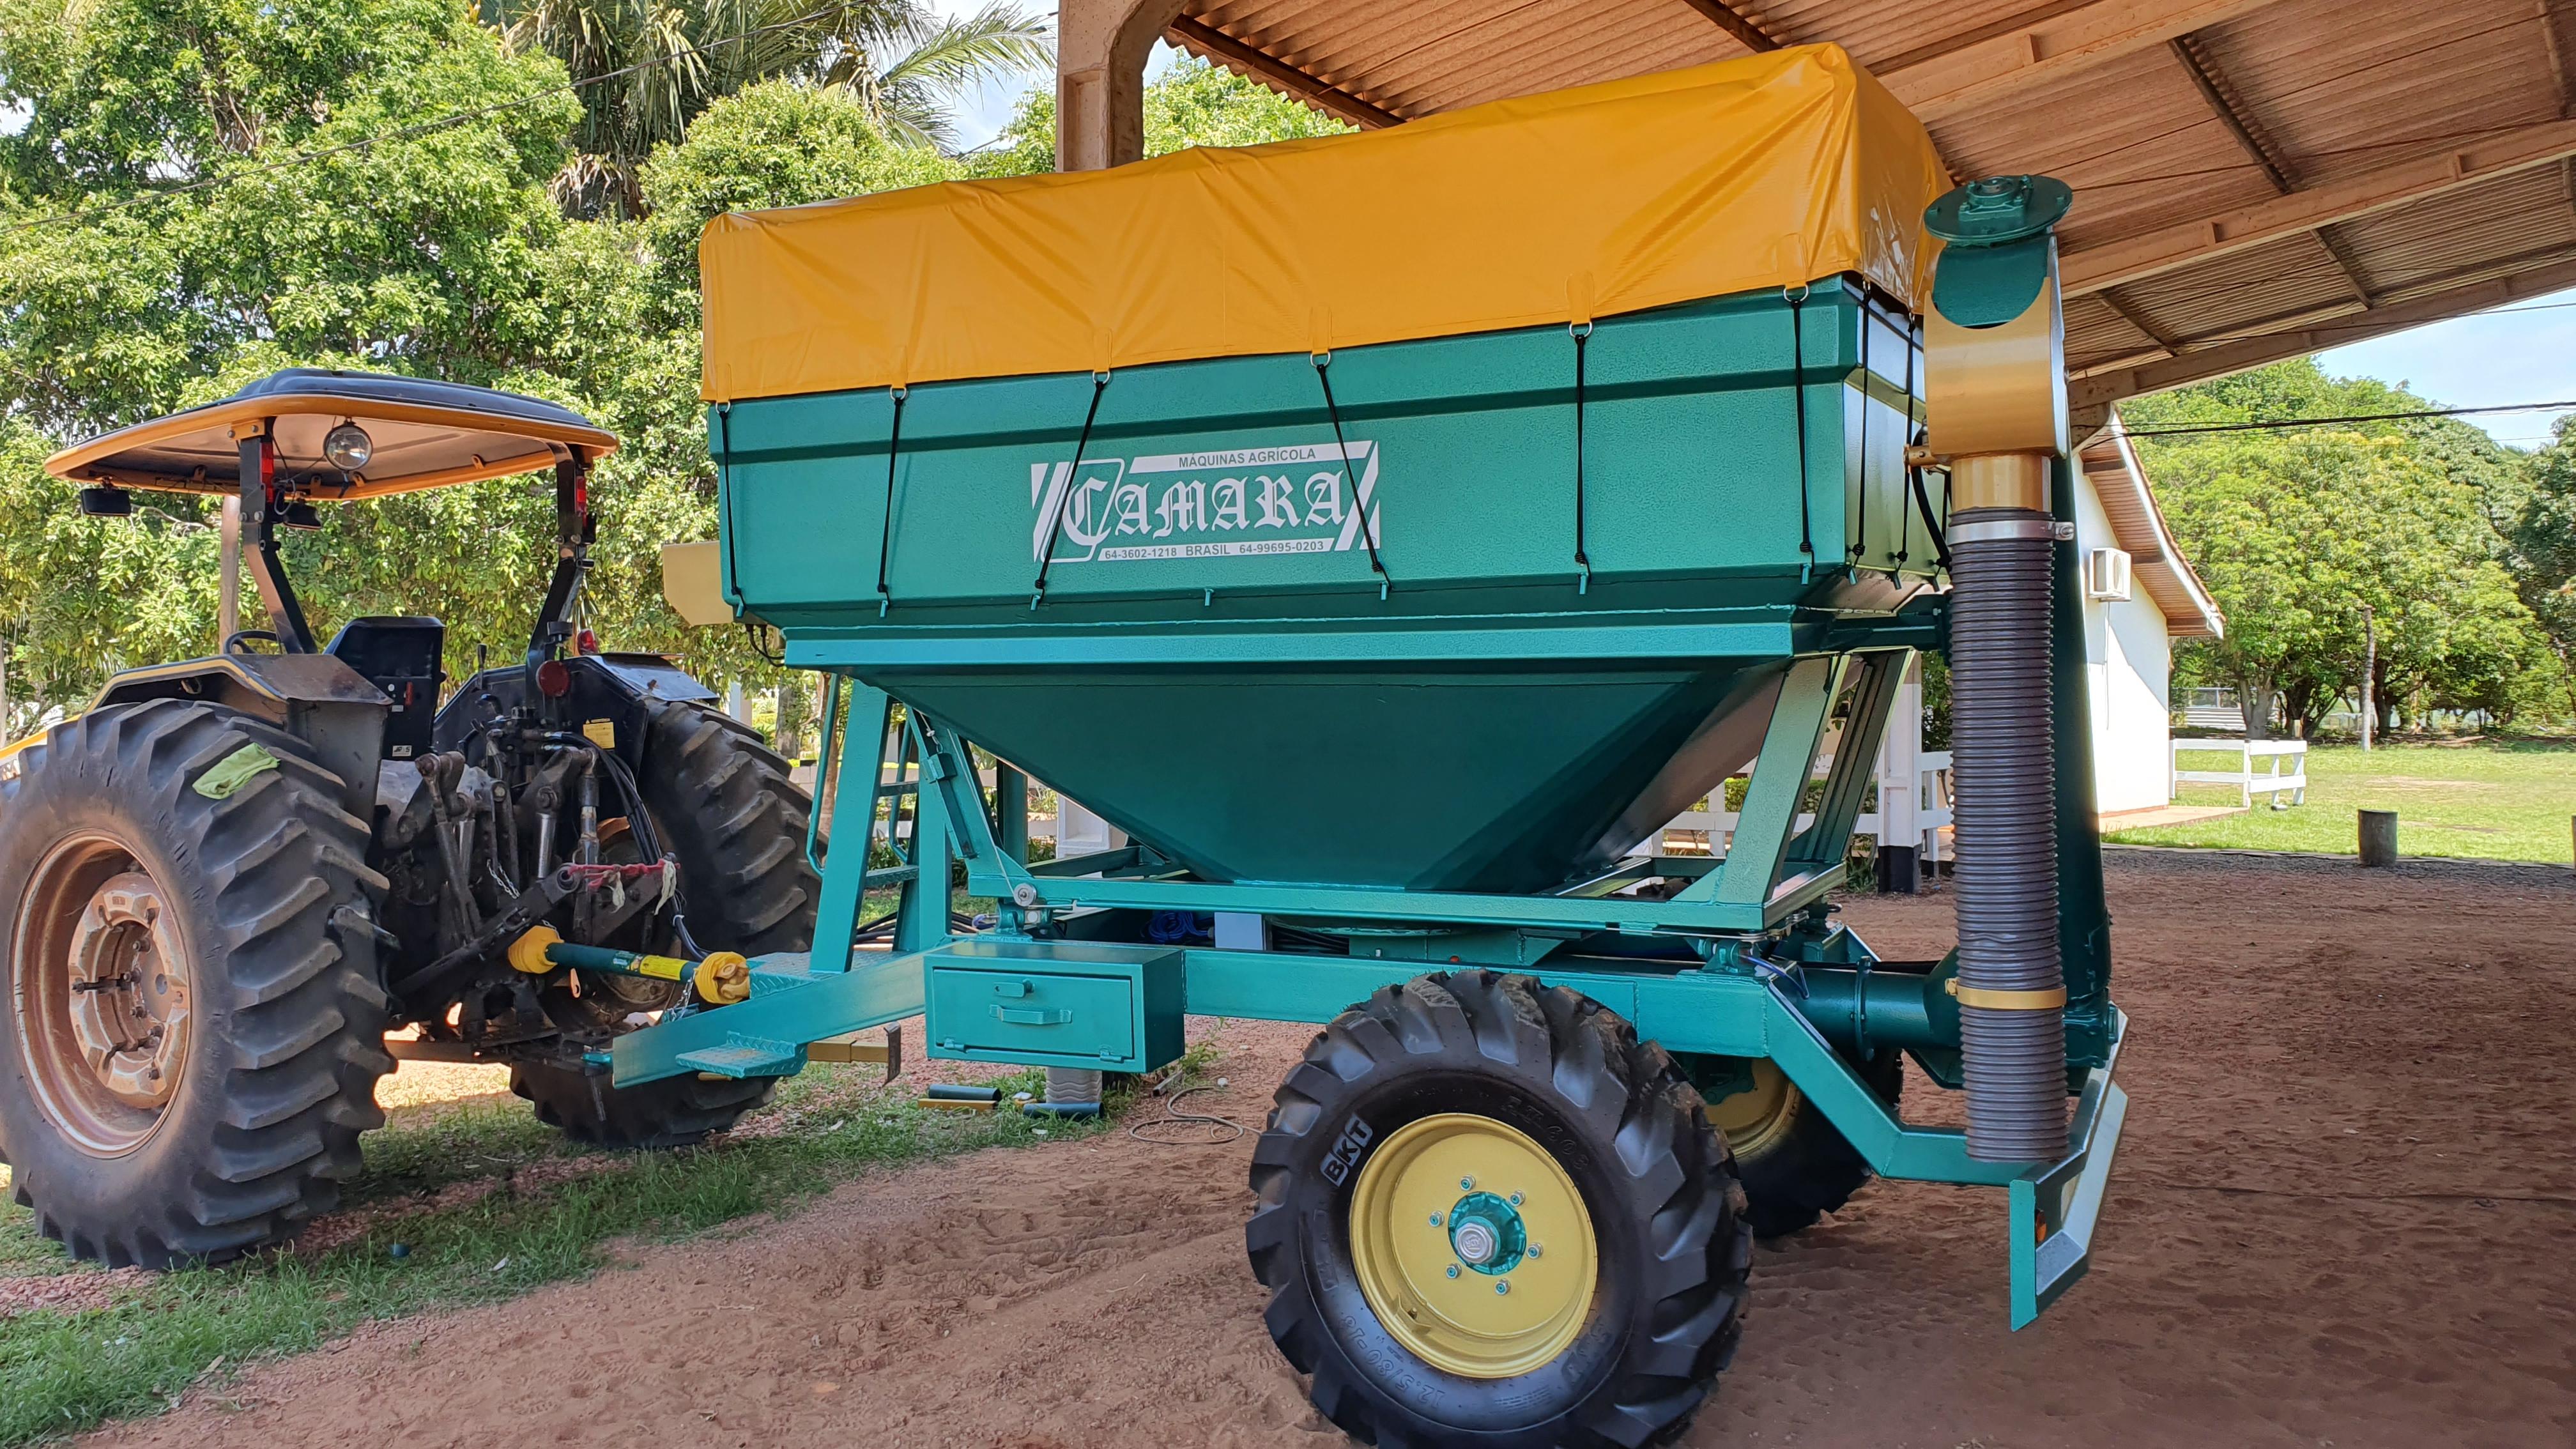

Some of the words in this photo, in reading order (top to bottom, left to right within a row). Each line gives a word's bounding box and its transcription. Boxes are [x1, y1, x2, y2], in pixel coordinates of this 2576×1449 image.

[1179, 453, 1245, 468] MÁQUINAS
[1248, 448, 1316, 464] AGRÍCOLA
[1062, 470, 1346, 546] CAMARA
[1104, 547, 1177, 560] 64-3602-1218
[1186, 544, 1230, 556] BRASIL
[1239, 541, 1324, 554] 64-99695-0203
[1322, 1116, 1371, 1185] BKT
[1340, 1315, 1445, 1409] 12.5/80-18
